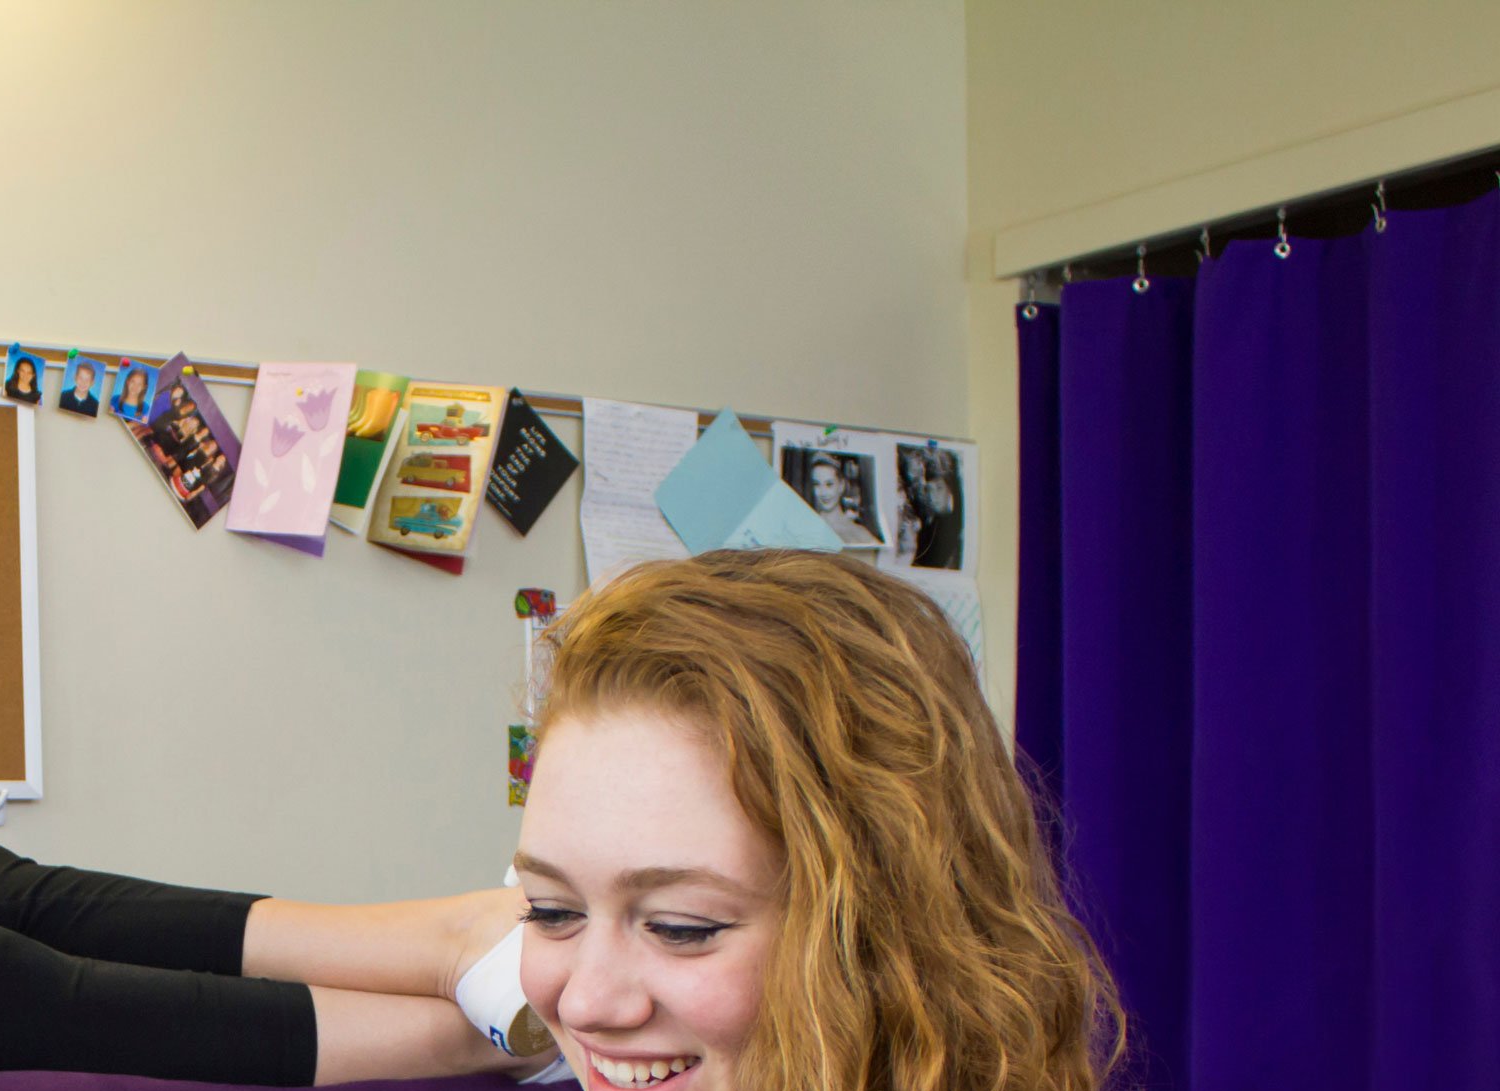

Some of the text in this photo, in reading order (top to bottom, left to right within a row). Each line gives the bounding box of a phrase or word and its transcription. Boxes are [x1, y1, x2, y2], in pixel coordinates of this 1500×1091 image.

[514, 446, 530, 466] THE
[521, 443, 534, 456] AT
[505, 462, 518, 476] OF
[508, 453, 526, 473] END
[488, 469, 520, 503] OMFORT
[496, 464, 518, 488] YOUR
